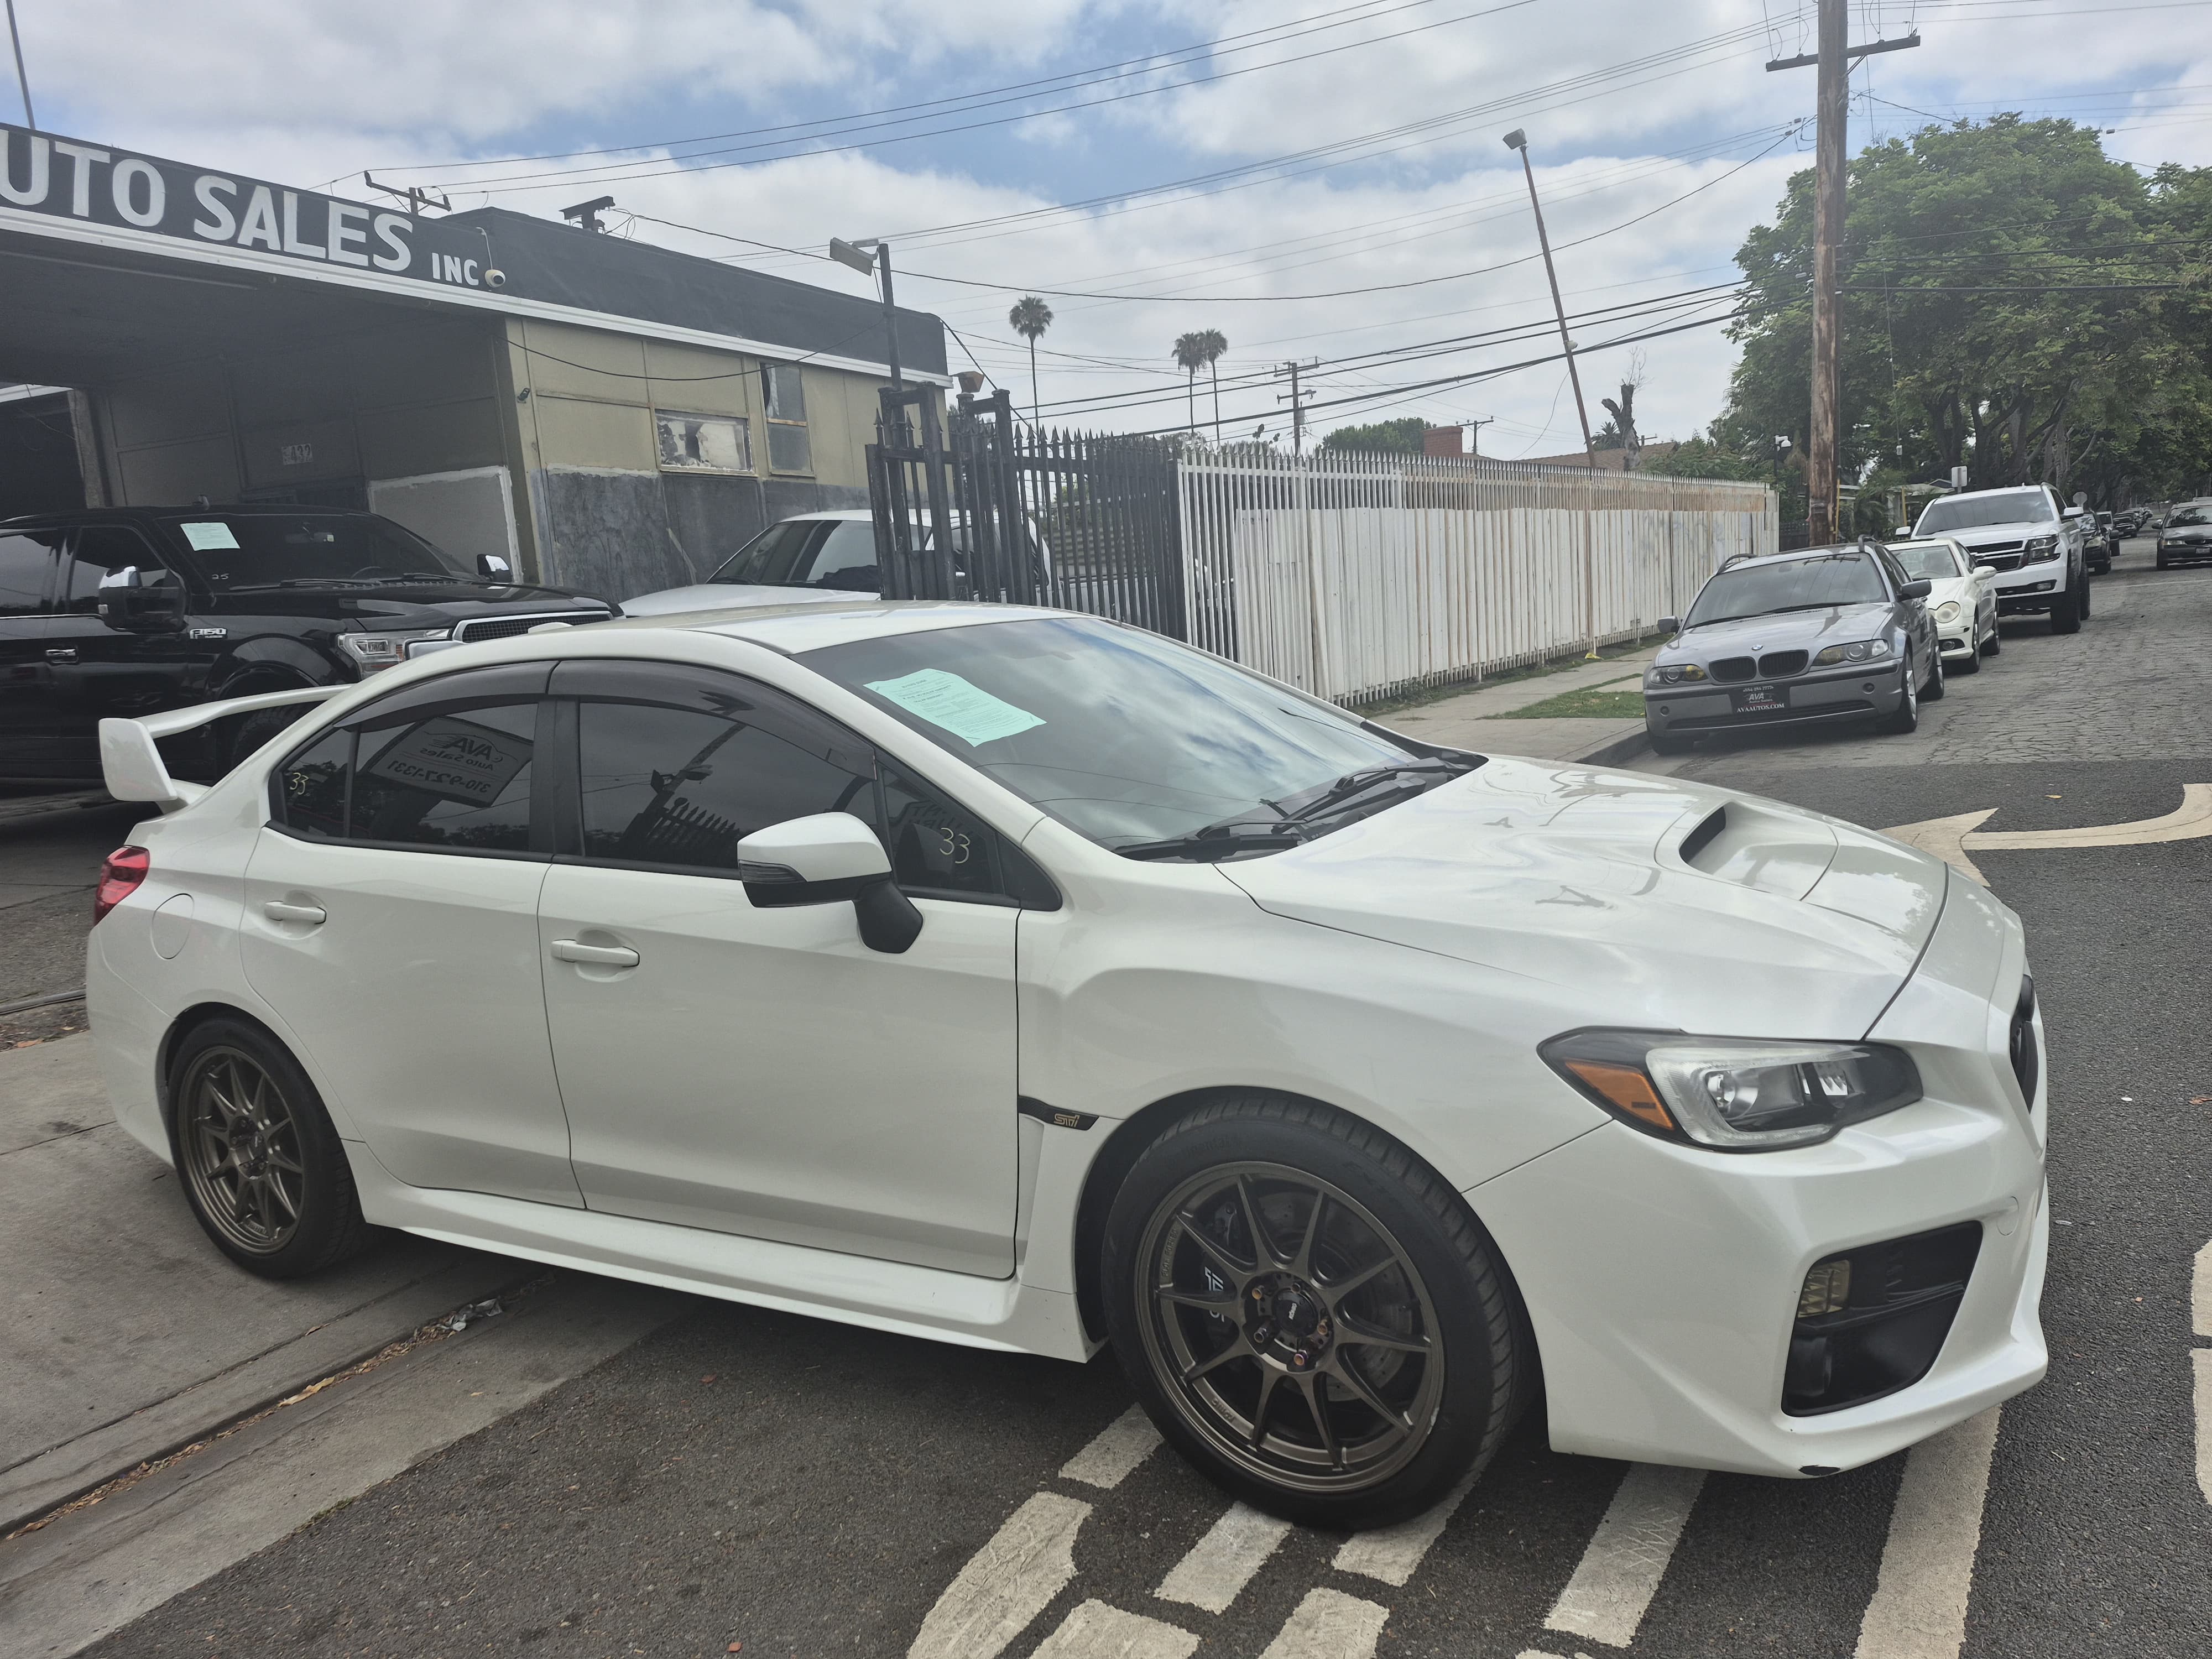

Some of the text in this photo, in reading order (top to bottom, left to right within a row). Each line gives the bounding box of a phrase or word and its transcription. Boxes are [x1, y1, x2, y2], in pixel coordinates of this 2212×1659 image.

[194, 175, 413, 271] SALES
[432, 252, 479, 286] INC
[1737, 703, 1785, 713] AVAAUTOS.COM
[1749, 692, 1765, 701] AVA
[289, 772, 309, 795] 33
[939, 827, 971, 864] 33
